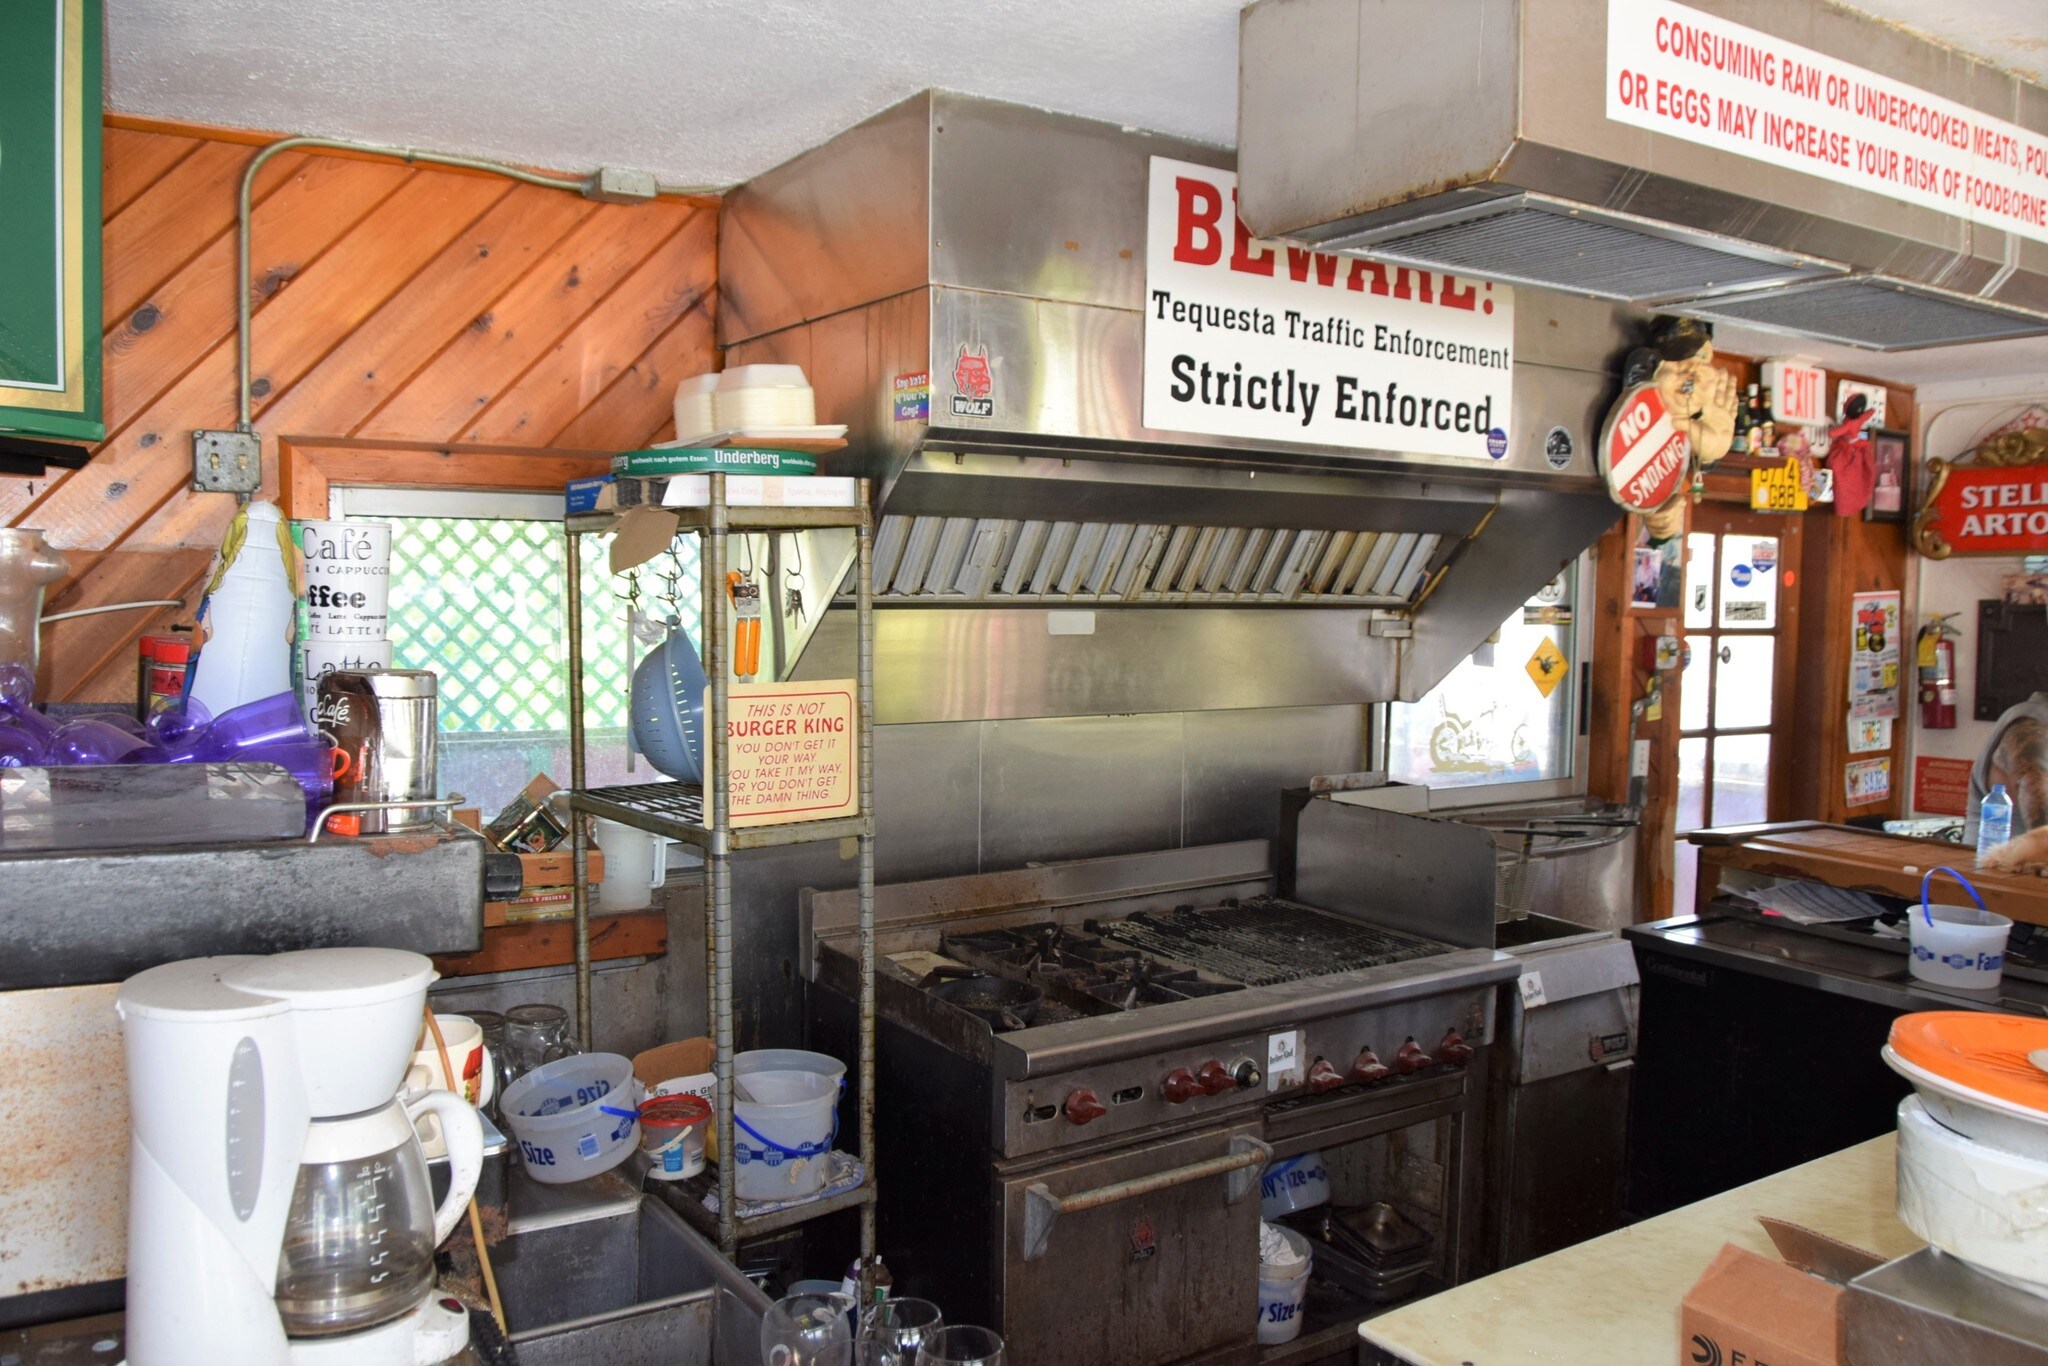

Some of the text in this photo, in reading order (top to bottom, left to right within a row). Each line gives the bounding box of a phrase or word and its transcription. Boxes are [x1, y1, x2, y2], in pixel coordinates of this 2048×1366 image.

[1656, 16, 1775, 87] CONSUMING
[1782, 58, 1820, 101] RAW
[1827, 74, 1849, 112] OR
[1854, 86, 1969, 150] UNDERCOOKED
[1973, 126, 2022, 175] MEATS,
[1618, 69, 2047, 227] OR EGGS MAY INCREASE YOUR RISK OF FOODBORNE
[1152, 290, 1510, 370] Tequesta Traffic Enforcement
[1170, 354, 1493, 436] Strictly Enforced
[1783, 367, 1819, 420] EXIT
[954, 400, 991, 415] WOLF
[1619, 401, 1652, 448] NO
[689, 454, 708, 463] Essen
[714, 449, 780, 470] Underberg
[1629, 434, 1686, 508] SMOKING
[303, 526, 373, 561] Café
[748, 701, 825, 717] THIS IS NOT
[727, 716, 843, 737] BURGER KING
[736, 738, 836, 753] YOU DON'T GET IT
[758, 754, 788, 765] YOUR
[755, 767, 780, 778] TAKE
[785, 766, 794, 776] IT
[798, 765, 814, 775] MY
[728, 775, 837, 792] OR YOU DON'T GET
[731, 794, 751, 805] THE
[756, 791, 792, 804] DAMN
[521, 1140, 556, 1166] Size
[1268, 1301, 1296, 1323] Size
